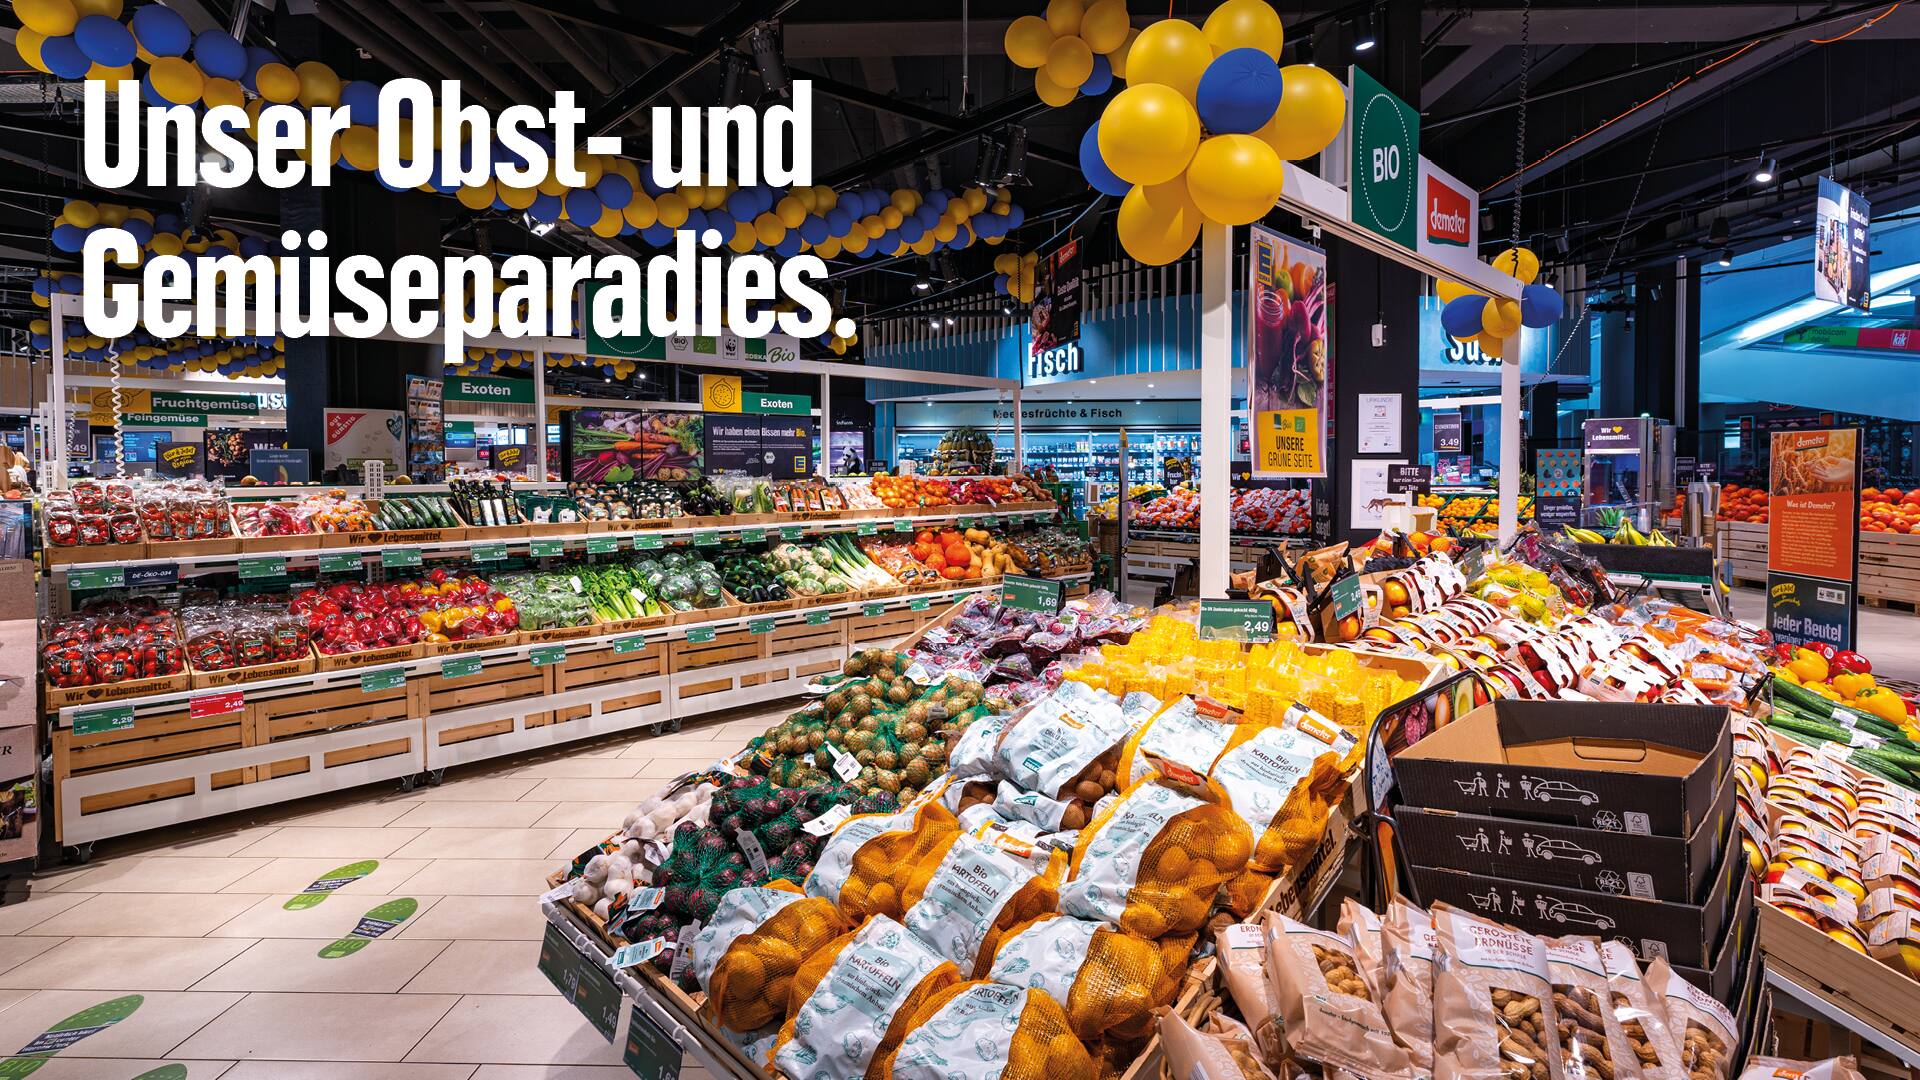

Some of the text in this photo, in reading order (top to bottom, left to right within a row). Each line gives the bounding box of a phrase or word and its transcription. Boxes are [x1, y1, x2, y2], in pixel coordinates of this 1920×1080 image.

[1373, 145, 1400, 183] BIO
[1431, 198, 1466, 235] demeter
[1893, 333, 1907, 347] kik
[768, 347, 795, 363] Bio
[461, 382, 511, 396] Exoten
[153, 397, 256, 412] Fruchtgemüse
[761, 398, 793, 409] Exoten
[127, 413, 200, 424] Feingemüse
[993, 408, 1122, 419] Meeesfrüchte & Fisch
[713, 427, 724, 436] Wir
[725, 427, 743, 436] haben
[744, 427, 760, 437] einen
[761, 427, 780, 437] Bissen
[781, 428, 795, 437] mehr
[1276, 436, 1304, 451] UNSERE
[1797, 437, 1825, 447] demeter
[1268, 452, 1312, 468] GRÜNE SEITE
[1400, 468, 1419, 476] BITTE
[1787, 500, 1798, 508] Was
[1808, 501, 1836, 510] Demeter?
[349, 531, 442, 544] Wir Lebensmittel.
[132, 571, 171, 579] DE-ÖKO-034
[1038, 596, 1057, 607] 1,69
[1244, 620, 1269, 633] 2,49
[1773, 612, 1842, 642] Jeder Beutel
[437, 639, 507, 653] Wir Lebensmittel
[334, 649, 413, 666] Wir Lebensmittel.
[209, 665, 300, 684] Wir Lebensmittel.
[65, 681, 173, 701] Wir Lebensmittel.
[225, 700, 243, 708] 2,49
[112, 716, 133, 725] 2,29
[1300, 719, 1331, 740] demeter
[1276, 754, 1290, 765] Bio
[973, 865, 988, 880] Bio
[1271, 829, 1337, 914] ebensmittel.
[967, 900, 984, 917] Anbau
[1470, 925, 1533, 945] GERÖSTETE
[333, 940, 364, 949] BIO
[1474, 937, 1533, 956] ERDNÜSSE
[874, 956, 890, 968] Bio
[563, 969, 576, 989] 1,79
[849, 953, 902, 992] KARTOFFELN
[867, 994, 885, 1012] Anbau
[602, 1006, 618, 1030] 1,49
[1, 1060, 41, 1073] BIO
